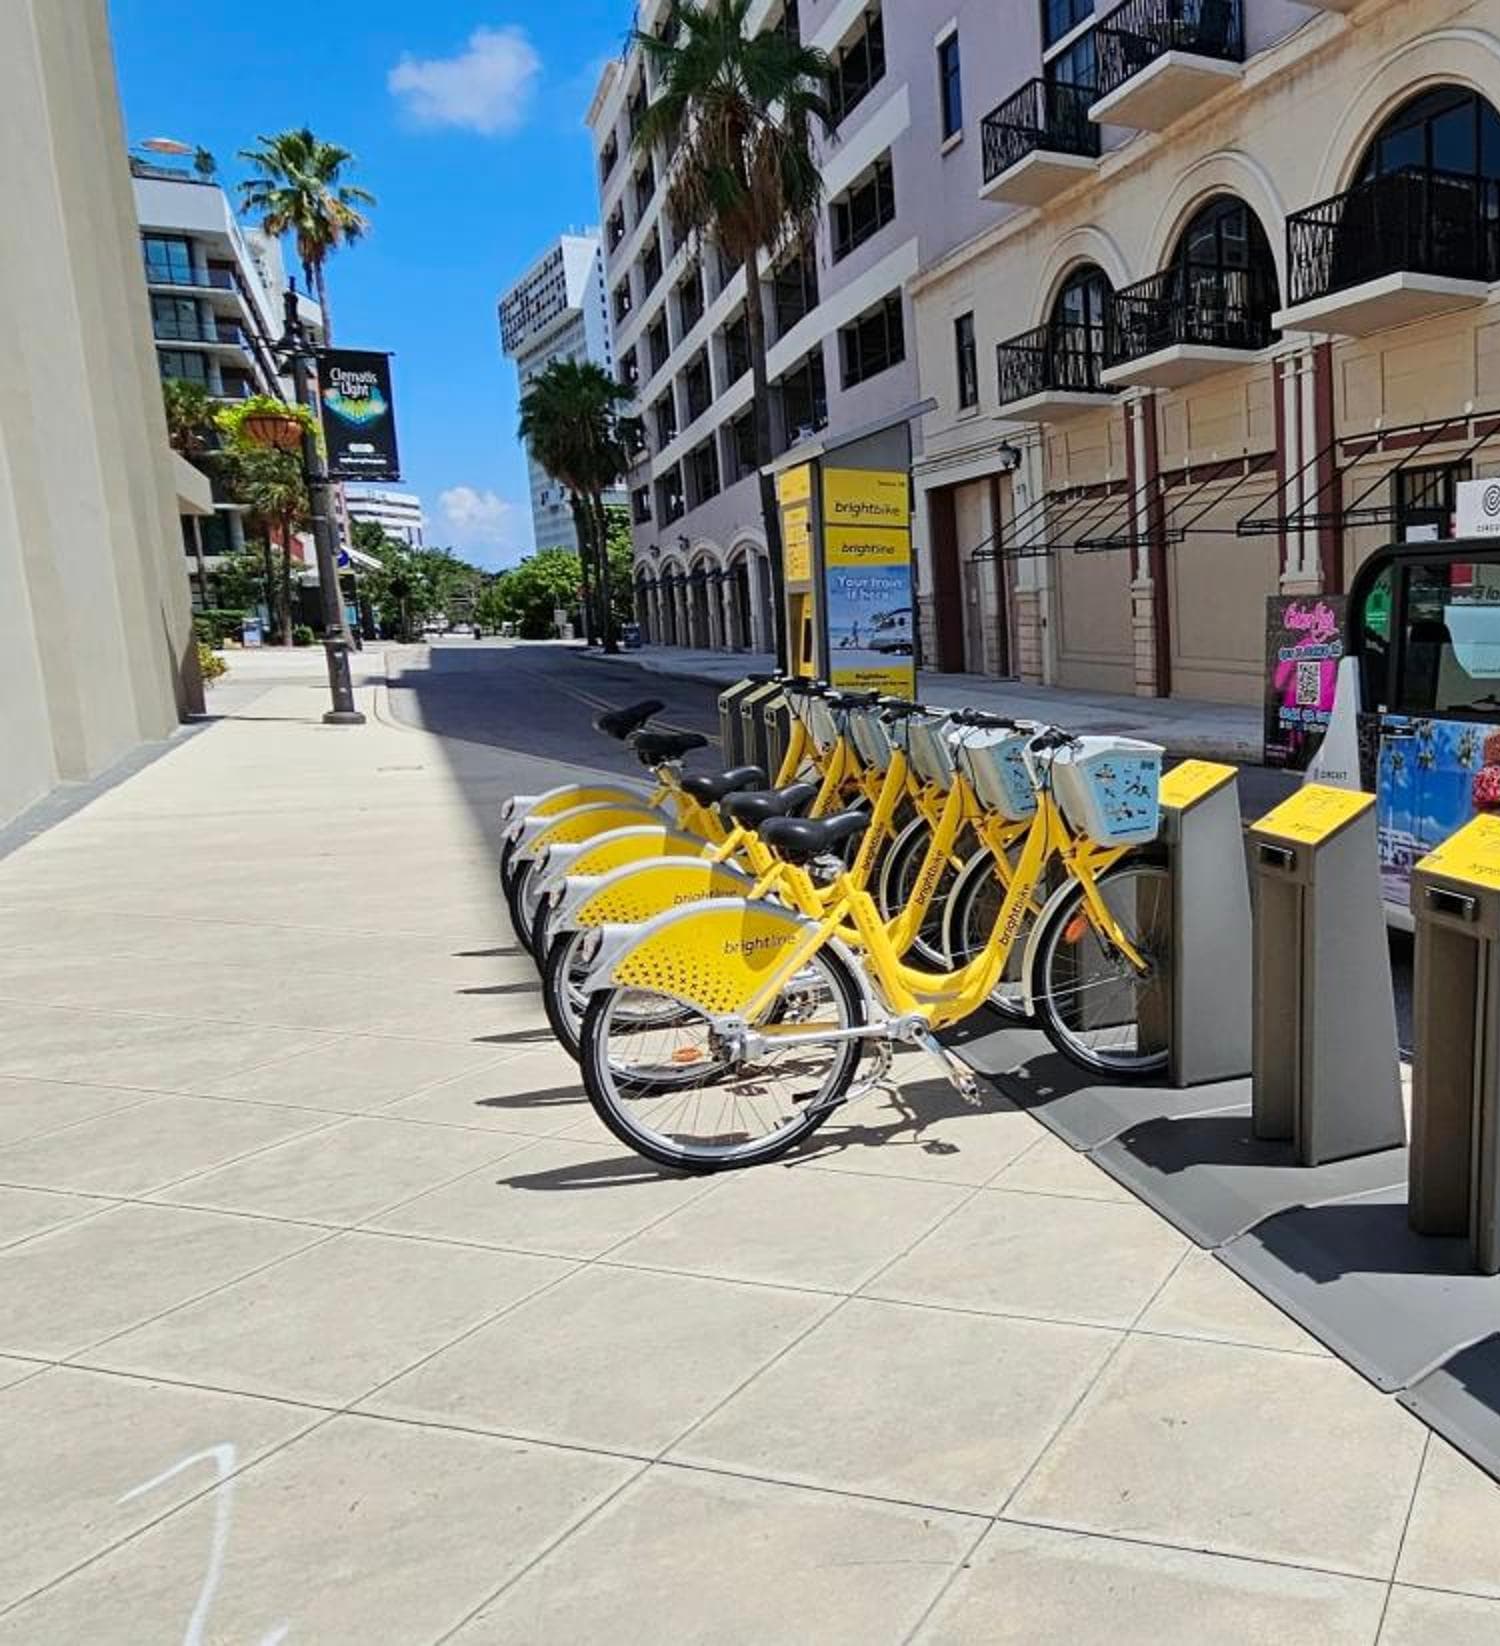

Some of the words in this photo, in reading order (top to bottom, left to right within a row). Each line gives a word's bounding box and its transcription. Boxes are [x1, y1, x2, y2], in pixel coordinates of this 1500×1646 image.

[330, 367, 378, 383] Clematis
[341, 381, 369, 398] Light
[834, 501, 901, 518] brightbike
[841, 543, 896, 557] brightline
[837, 575, 868, 589] Your
[917, 850, 944, 905] brightbike
[998, 883, 1031, 946] brightbike
[723, 932, 797, 957] brightline
